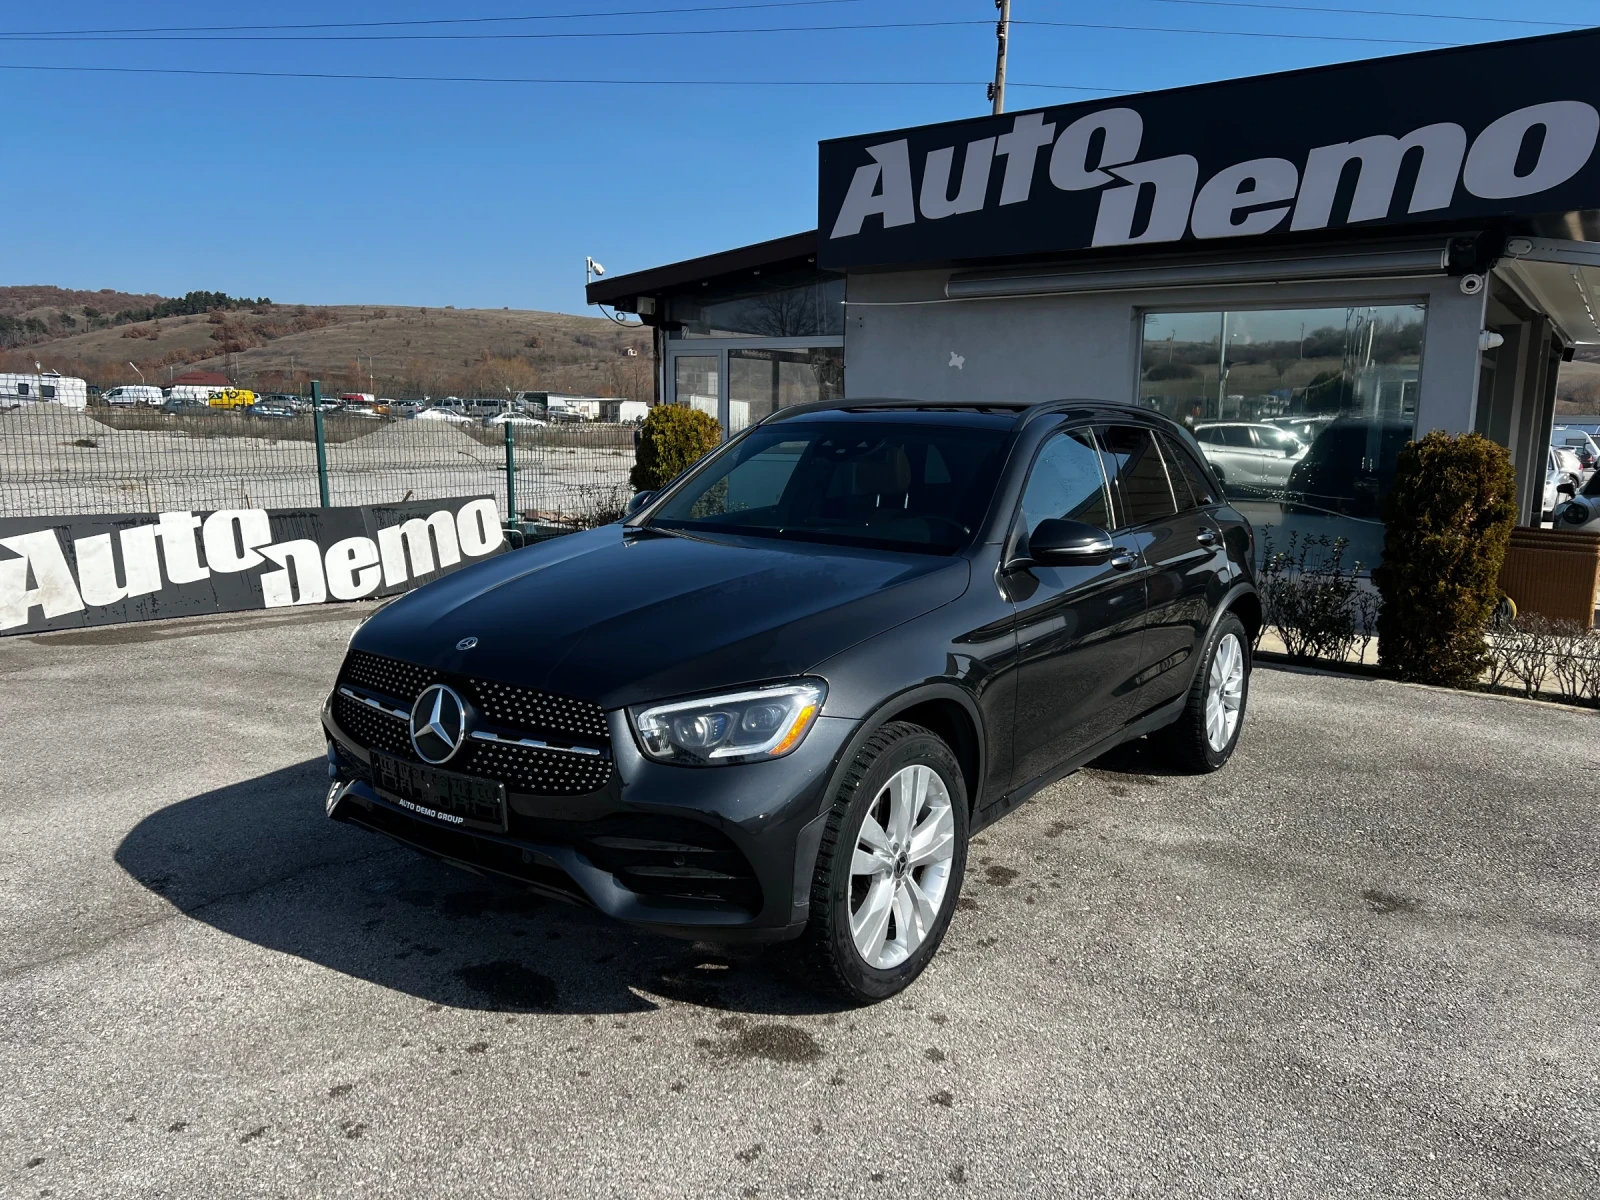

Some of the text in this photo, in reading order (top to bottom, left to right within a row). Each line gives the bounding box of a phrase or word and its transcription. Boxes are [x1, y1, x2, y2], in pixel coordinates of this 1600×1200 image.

[830, 100, 1599, 248] Auto Demo
[0, 498, 505, 631] Auto Demo
[399, 798, 464, 824] AUTO DEMO GROUP
